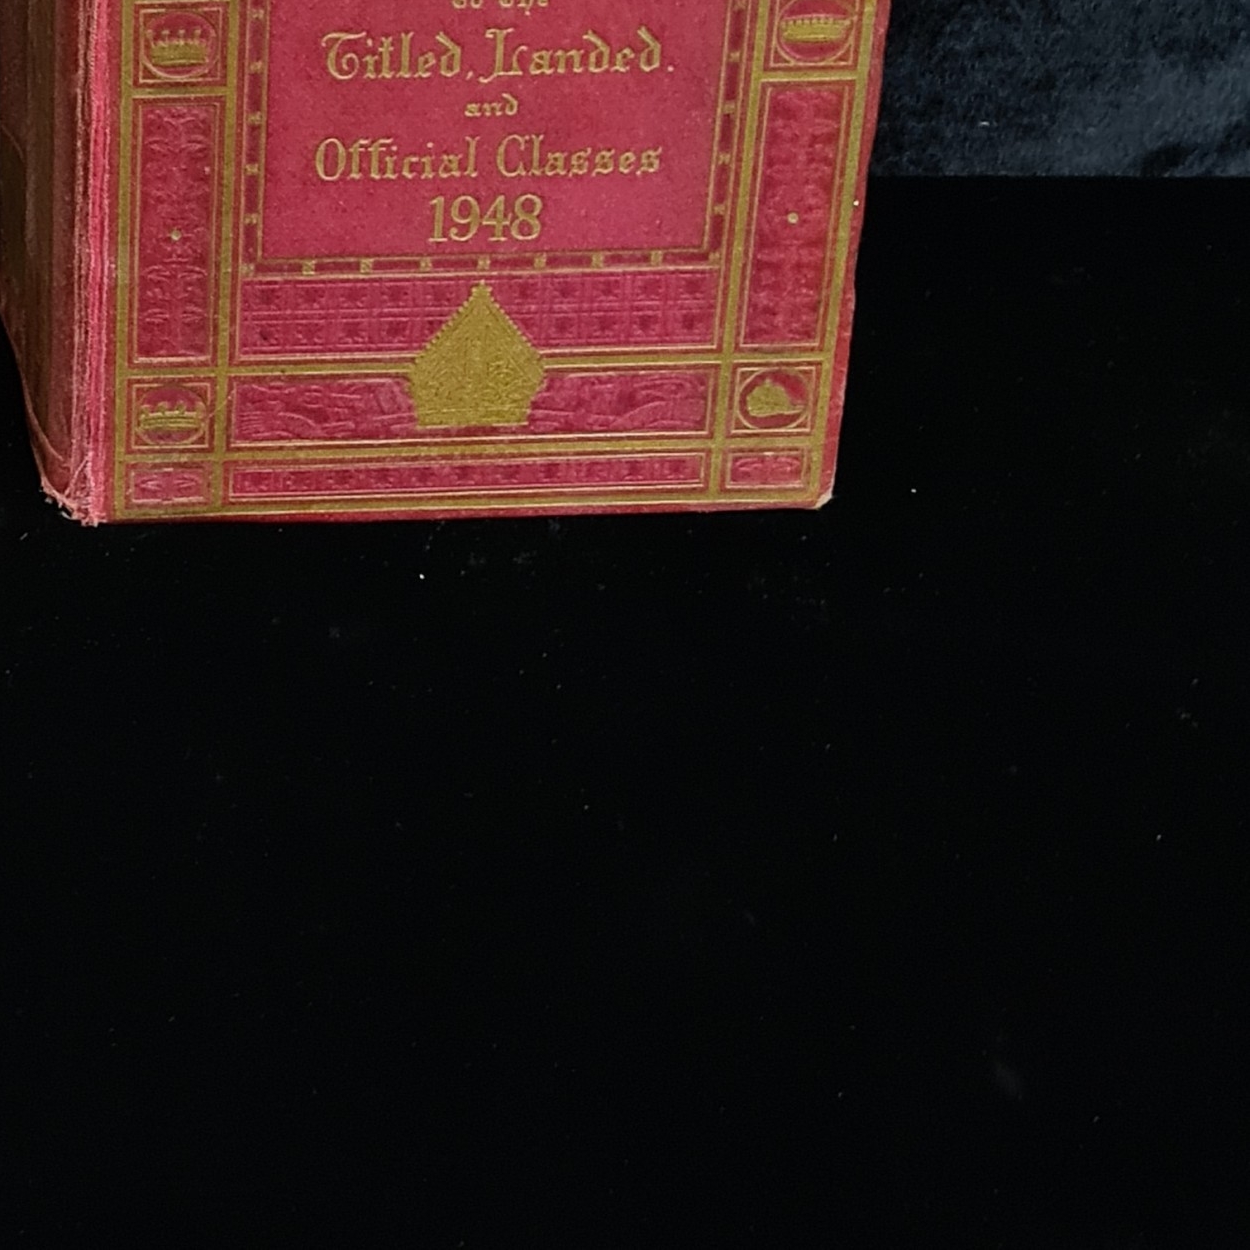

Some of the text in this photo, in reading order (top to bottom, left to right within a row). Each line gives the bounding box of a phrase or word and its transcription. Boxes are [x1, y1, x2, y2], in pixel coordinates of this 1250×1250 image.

[321, 31, 474, 80] Titled,
[464, 93, 519, 117] and
[315, 133, 664, 181] Official Classes
[428, 193, 544, 244] 1948
